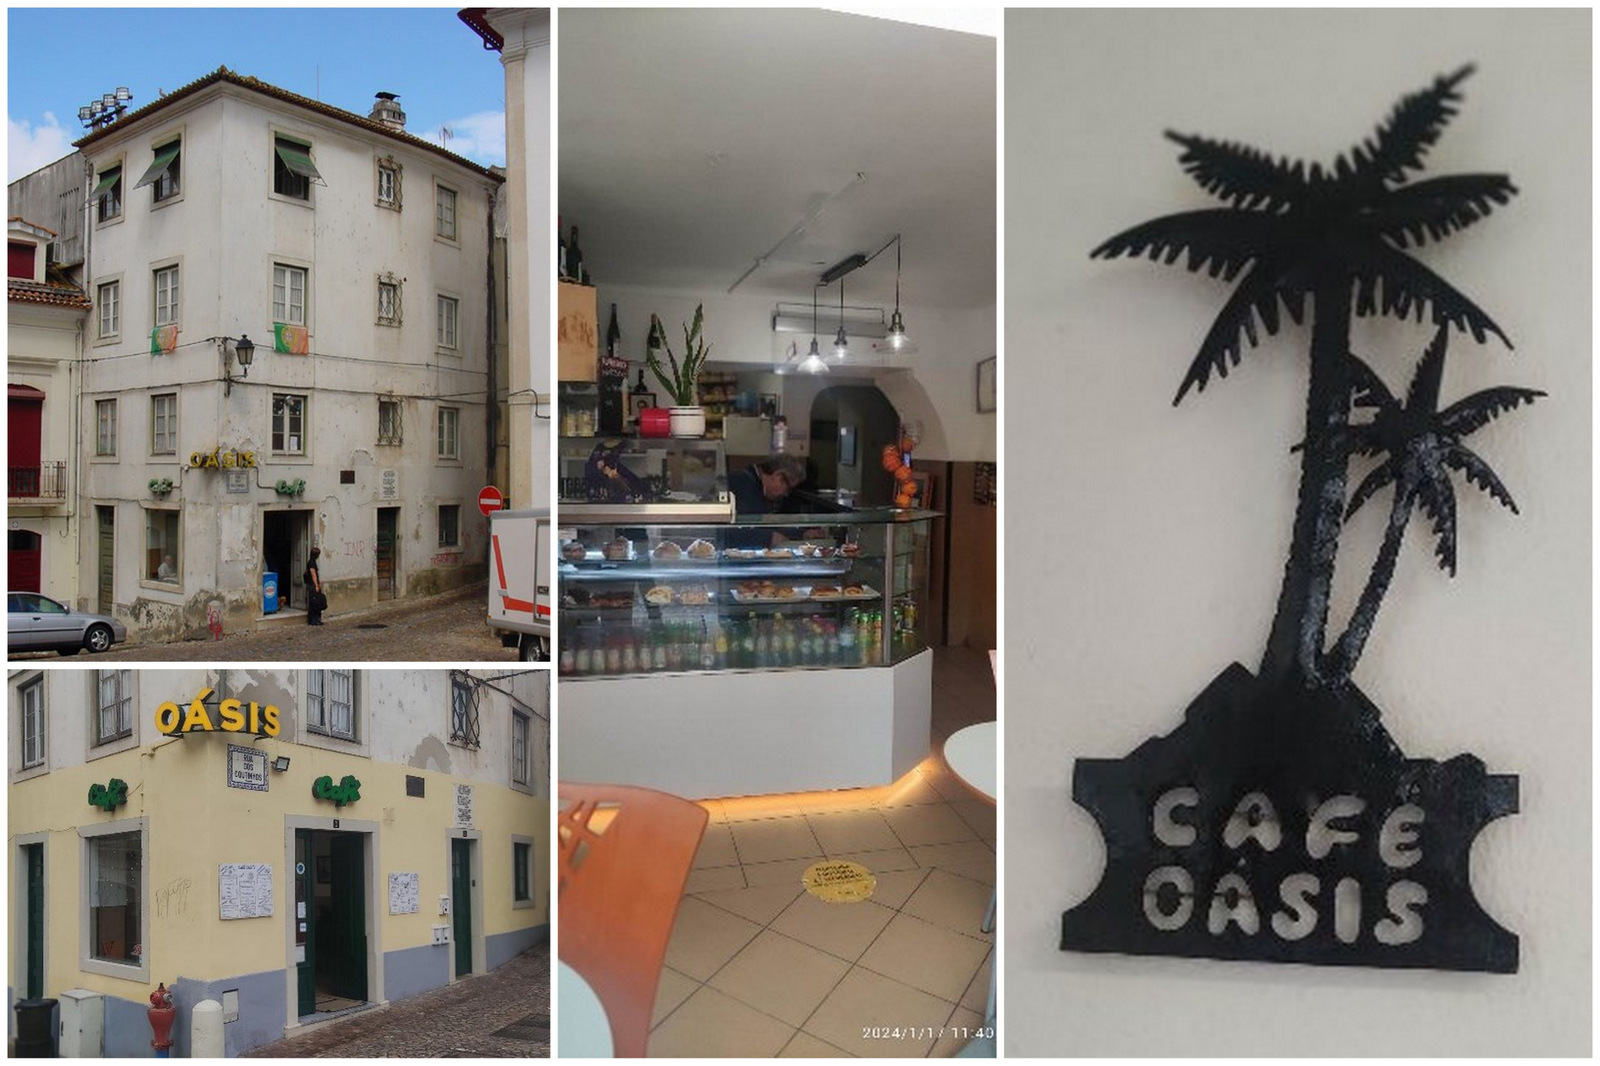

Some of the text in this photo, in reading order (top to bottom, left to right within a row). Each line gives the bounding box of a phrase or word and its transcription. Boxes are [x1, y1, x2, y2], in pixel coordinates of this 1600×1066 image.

[190, 444, 256, 469] OÁSIS
[154, 687, 281, 737] OÁSIS
[243, 762, 254, 771] DOS
